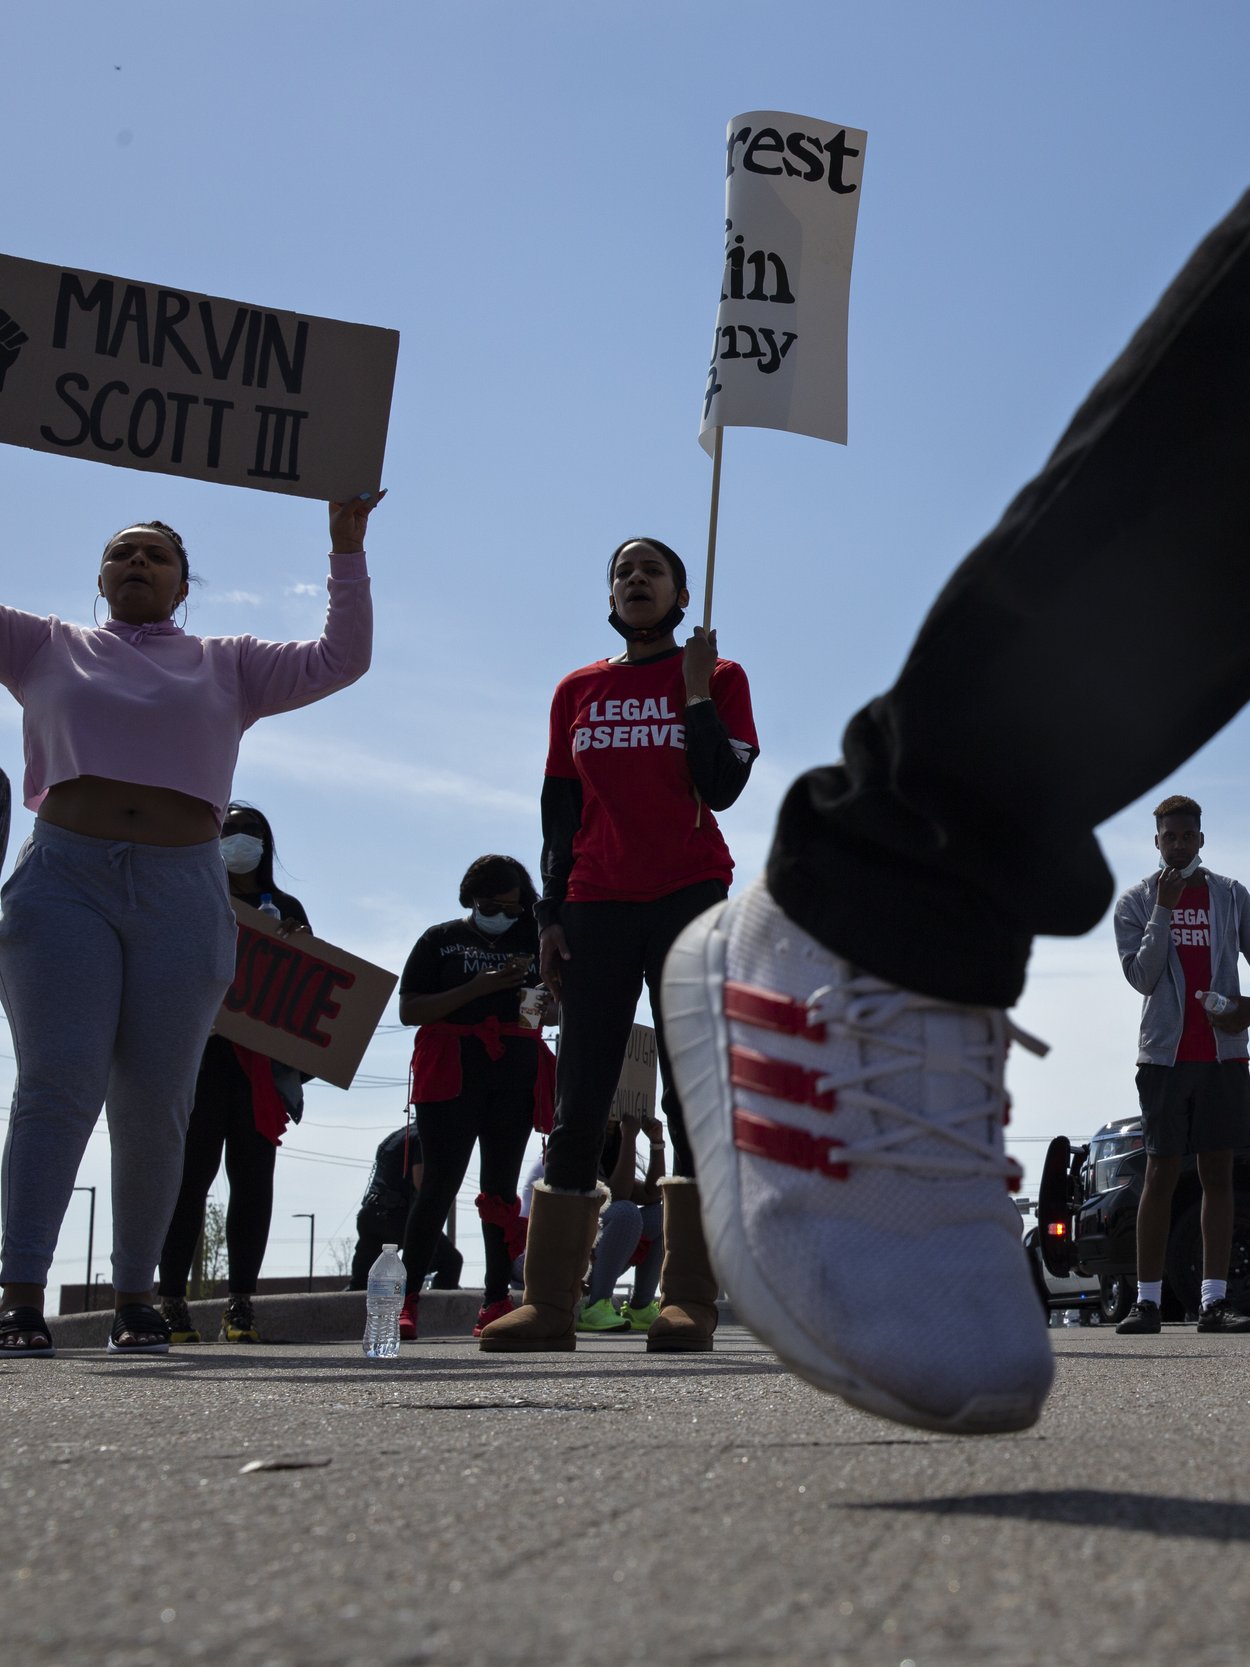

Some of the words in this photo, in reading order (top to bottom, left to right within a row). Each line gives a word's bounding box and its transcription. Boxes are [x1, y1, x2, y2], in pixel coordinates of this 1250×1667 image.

[719, 234, 796, 304] in
[52, 271, 310, 394] MARVIN
[39, 371, 235, 468] SCOTT
[246, 403, 310, 482] III
[588, 695, 677, 723] LEGAL
[1169, 908, 1210, 926] EGA
[626, 1029, 657, 1068] OUGH
